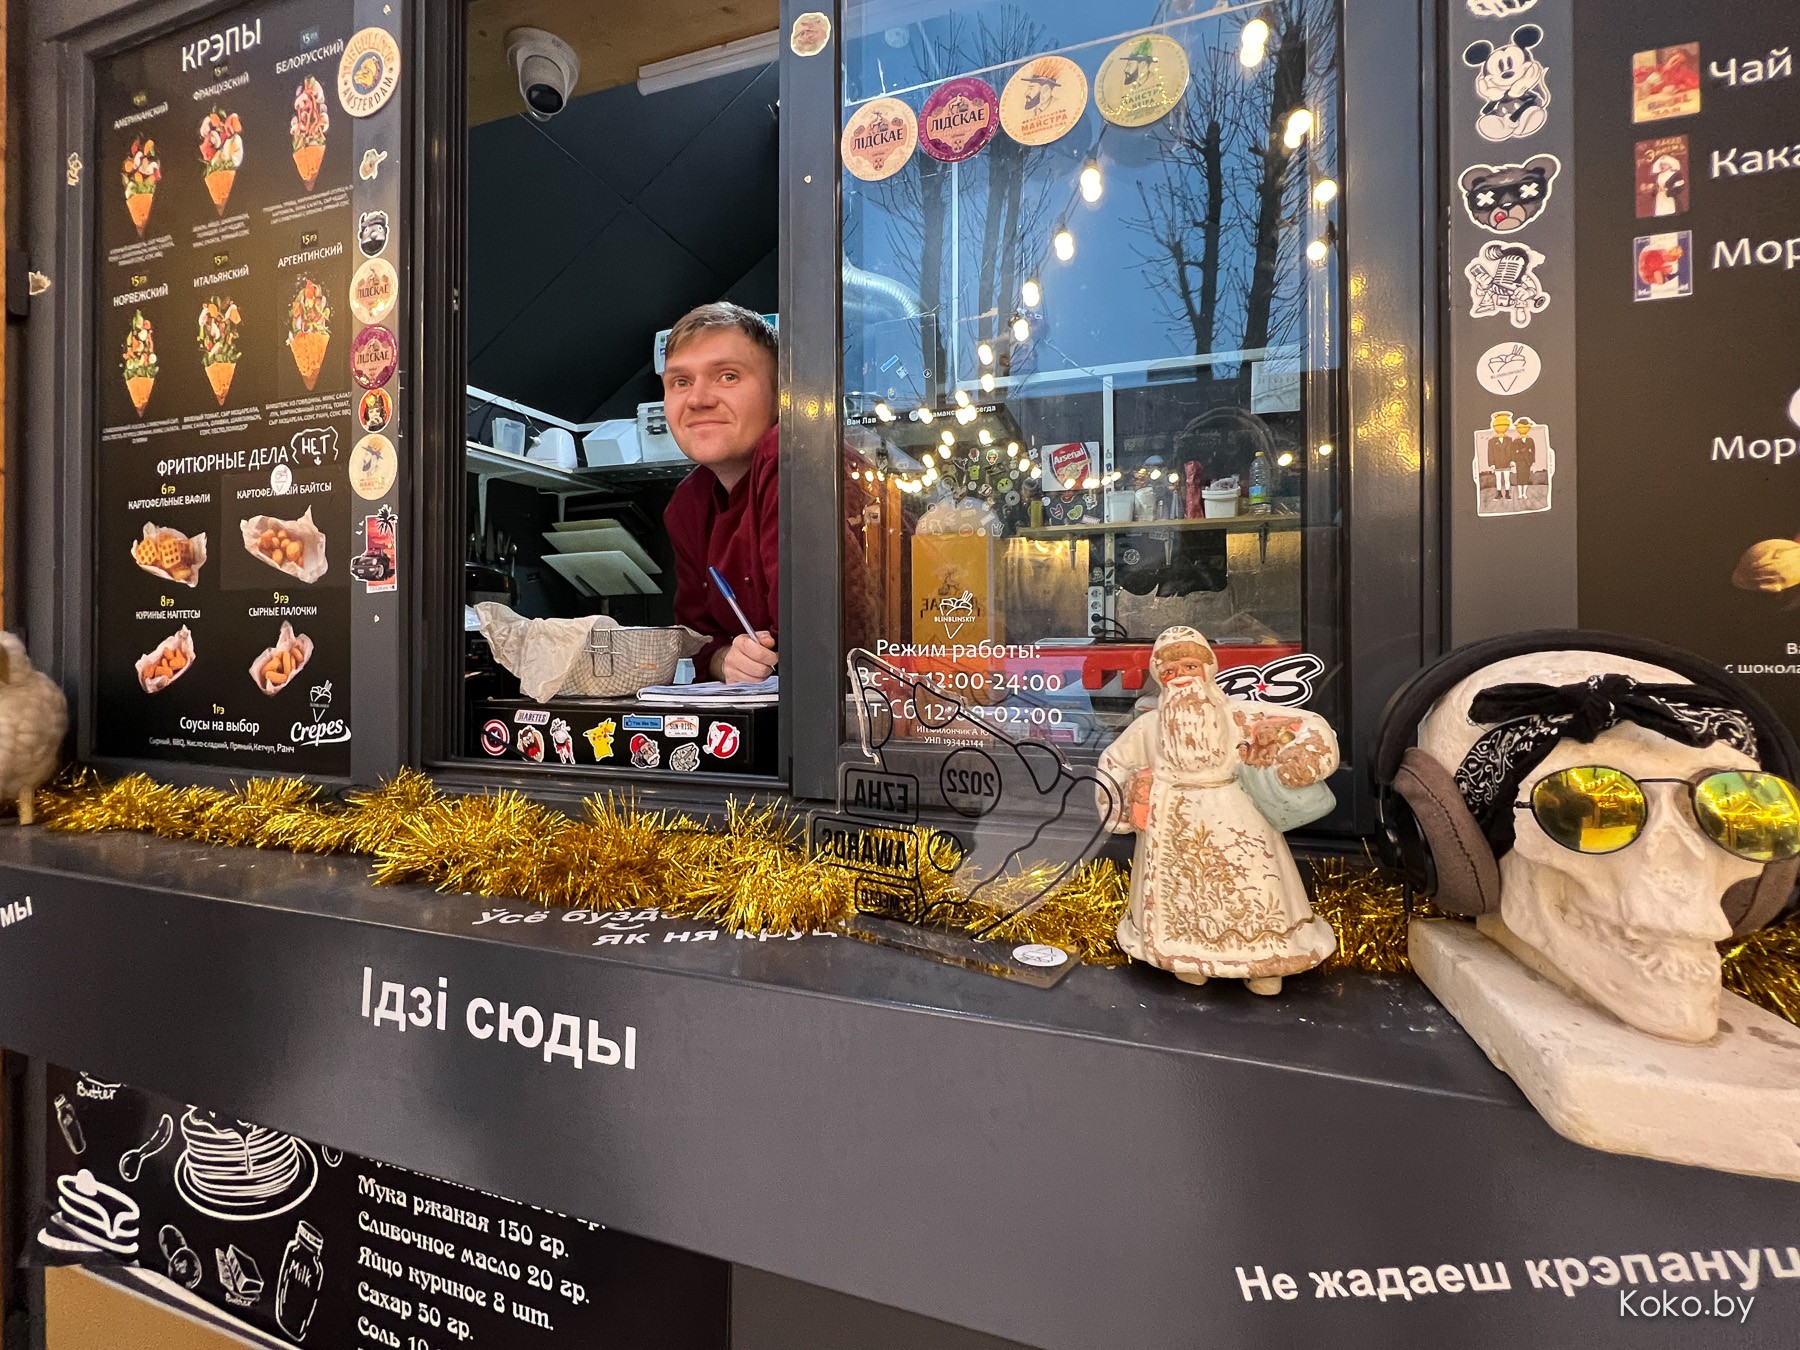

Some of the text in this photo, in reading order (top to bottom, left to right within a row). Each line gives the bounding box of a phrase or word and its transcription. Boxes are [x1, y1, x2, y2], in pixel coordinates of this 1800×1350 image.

[181, 18, 261, 72] КРЭПЫ
[275, 38, 344, 74] БЕЛОРУССКИЙ
[1709, 46, 1792, 86] Чай
[193, 72, 249, 100] ФРАНЦУЗСКИЙ
[342, 76, 394, 111] AMSTERDAM
[931, 108, 985, 132] ЛІДСКАЕ
[1020, 113, 1068, 132] МАЙСТРА
[853, 128, 904, 151] ЛІДСКАЕ
[278, 241, 343, 268] АРГЕНТИНСКИЙ
[193, 264, 249, 288] ИТАЛЬЯНСКИЙ
[113, 282, 169, 308] НОРВЕЖСКИЙ
[300, 433, 331, 456] НЕТ
[1054, 447, 1084, 465] Arsenal
[1711, 435, 1799, 465] Мор
[157, 445, 289, 477] ФРИТЮРНЫЕ ДЕЛА
[299, 481, 332, 494] БАЙТСЫ
[128, 492, 211, 511] КАРТОФЕЛЬНЫЕ ВАФЛИ
[135, 608, 201, 621] КУРИНЫЕ НАГГЕТСЫ
[248, 605, 318, 618] СЫРНЫЕ ПАЛОЧКИ
[876, 638, 1041, 664] Режим работы:
[925, 671, 1062, 695] 12:00-24:00
[179, 716, 260, 735] Соусы на выбор
[517, 712, 547, 723] DIABETES
[290, 719, 346, 747] Crepes
[924, 736, 941, 745] УНП
[276, 743, 295, 754] Ранч
[471, 907, 550, 926] Ўсё
[561, 906, 680, 926] бузд
[592, 932, 651, 946] як
[663, 929, 720, 943] ня
[361, 966, 637, 1070] Ідзі сюды
[76, 1080, 117, 1101] Butter
[357, 1174, 570, 1260] Мука ржаная 150 гр.
[357, 1210, 591, 1306] Сливочное масло 20 гр.
[288, 1258, 313, 1288] Milk
[1234, 1265, 1299, 1303] Не
[1306, 1259, 1512, 1304] жадаеш
[357, 1245, 555, 1332] Яйцо куриное 8 шт.
[357, 1280, 475, 1342] Сахар 50 гр.
[357, 1315, 402, 1349] Соль
